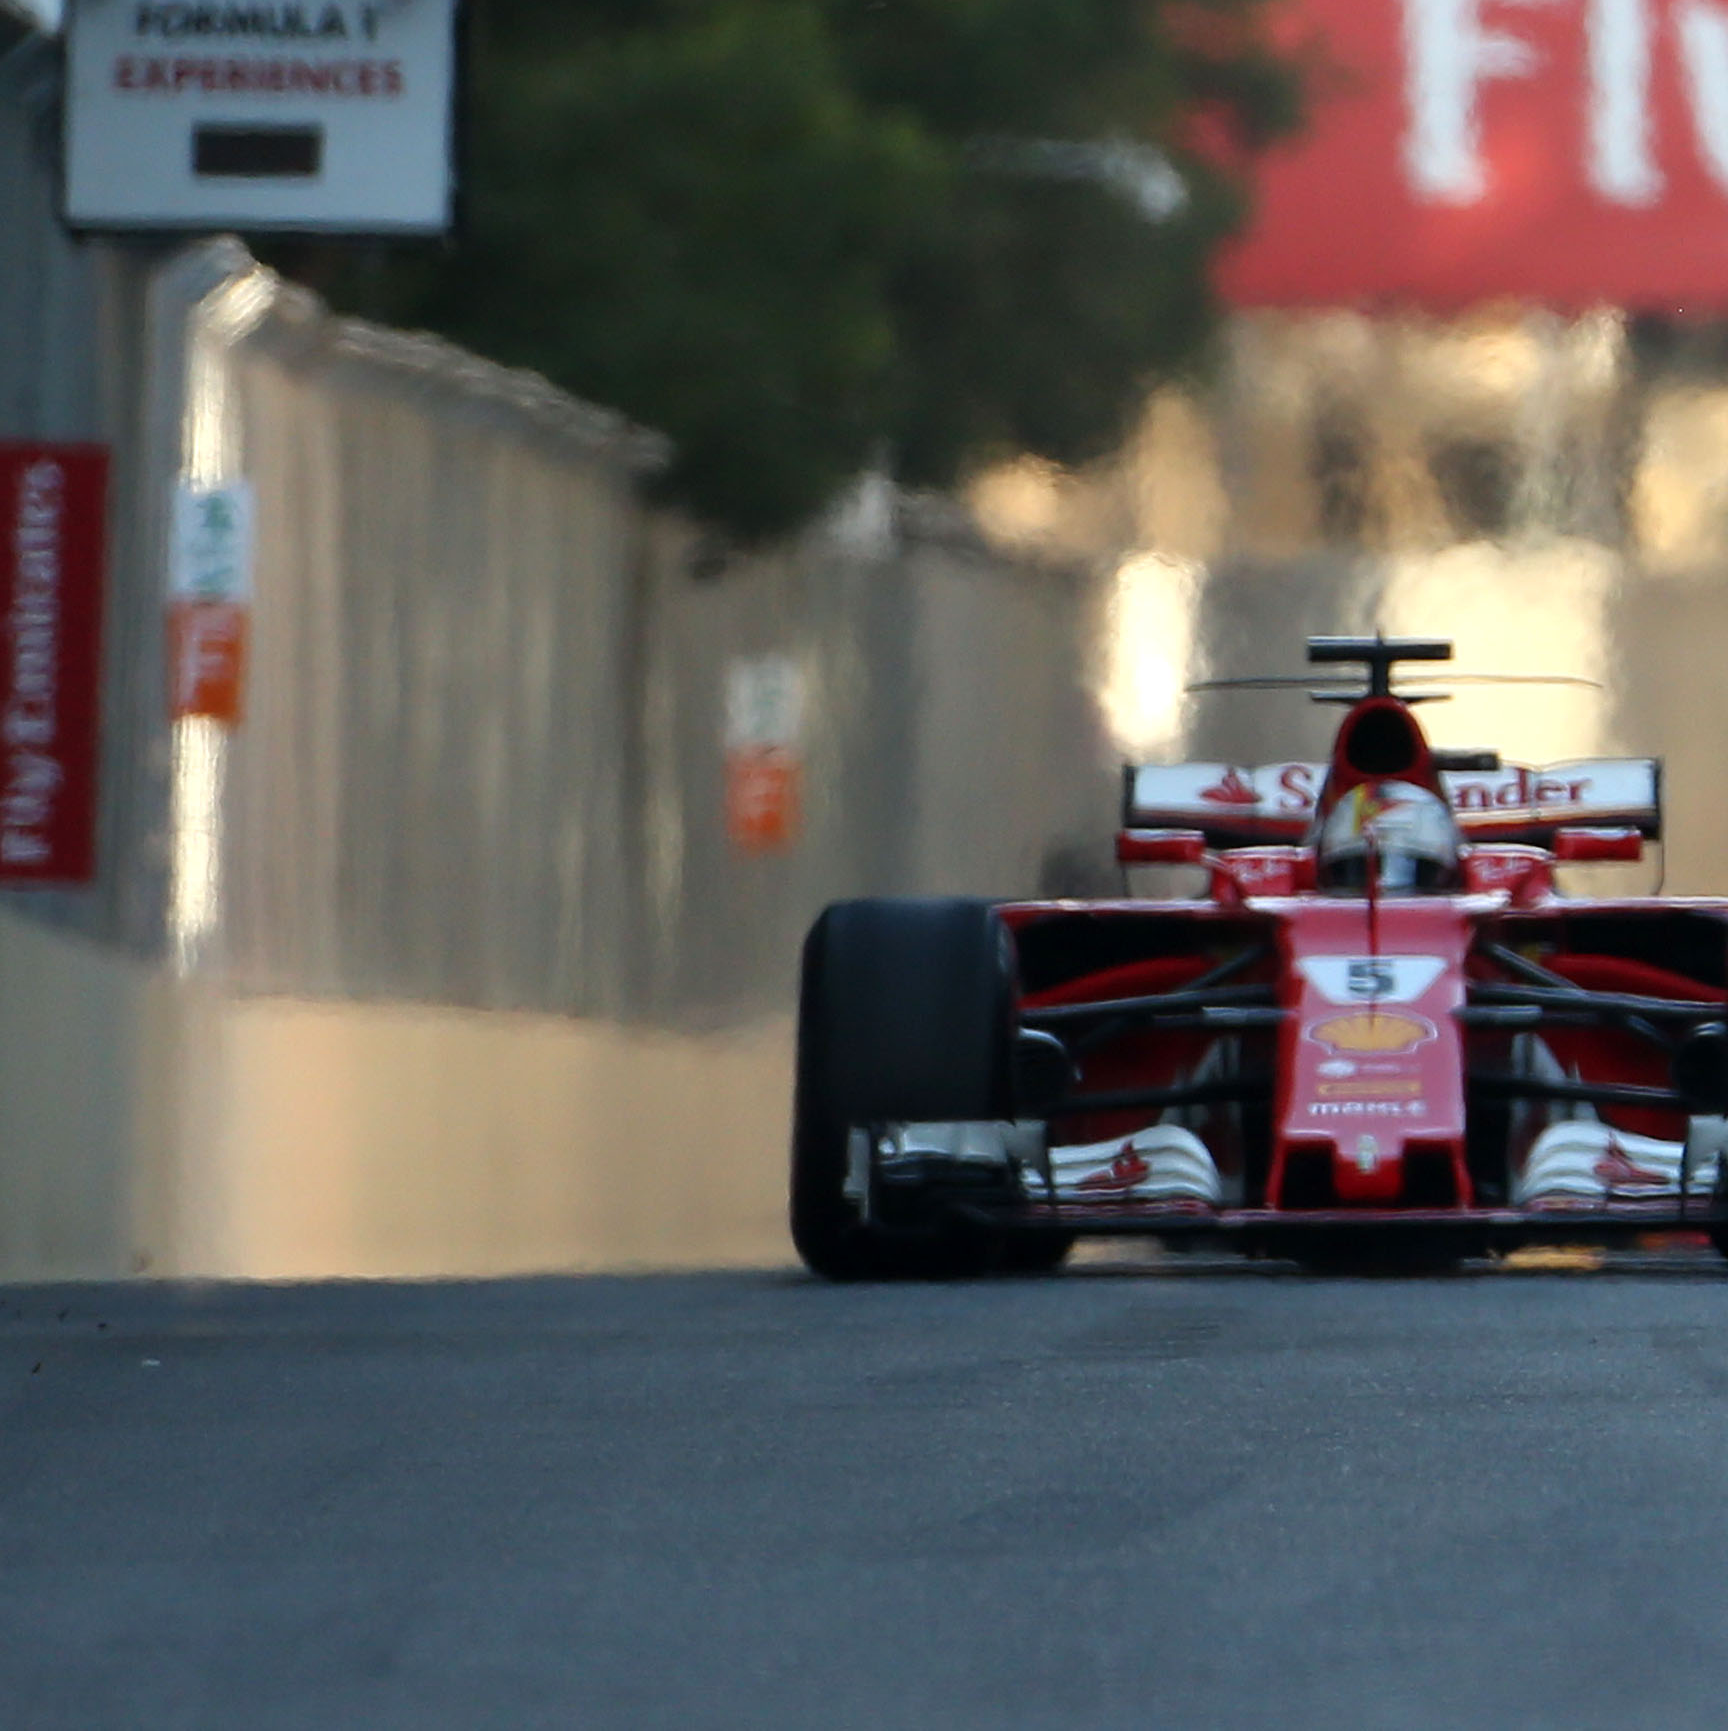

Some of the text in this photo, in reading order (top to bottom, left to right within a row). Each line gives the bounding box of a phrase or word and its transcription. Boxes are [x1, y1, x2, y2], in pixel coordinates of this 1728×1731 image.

[113, 56, 407, 96] EXPERIENCES
[1279, 765, 1593, 814] Snder
[1347, 959, 1396, 995] 5
